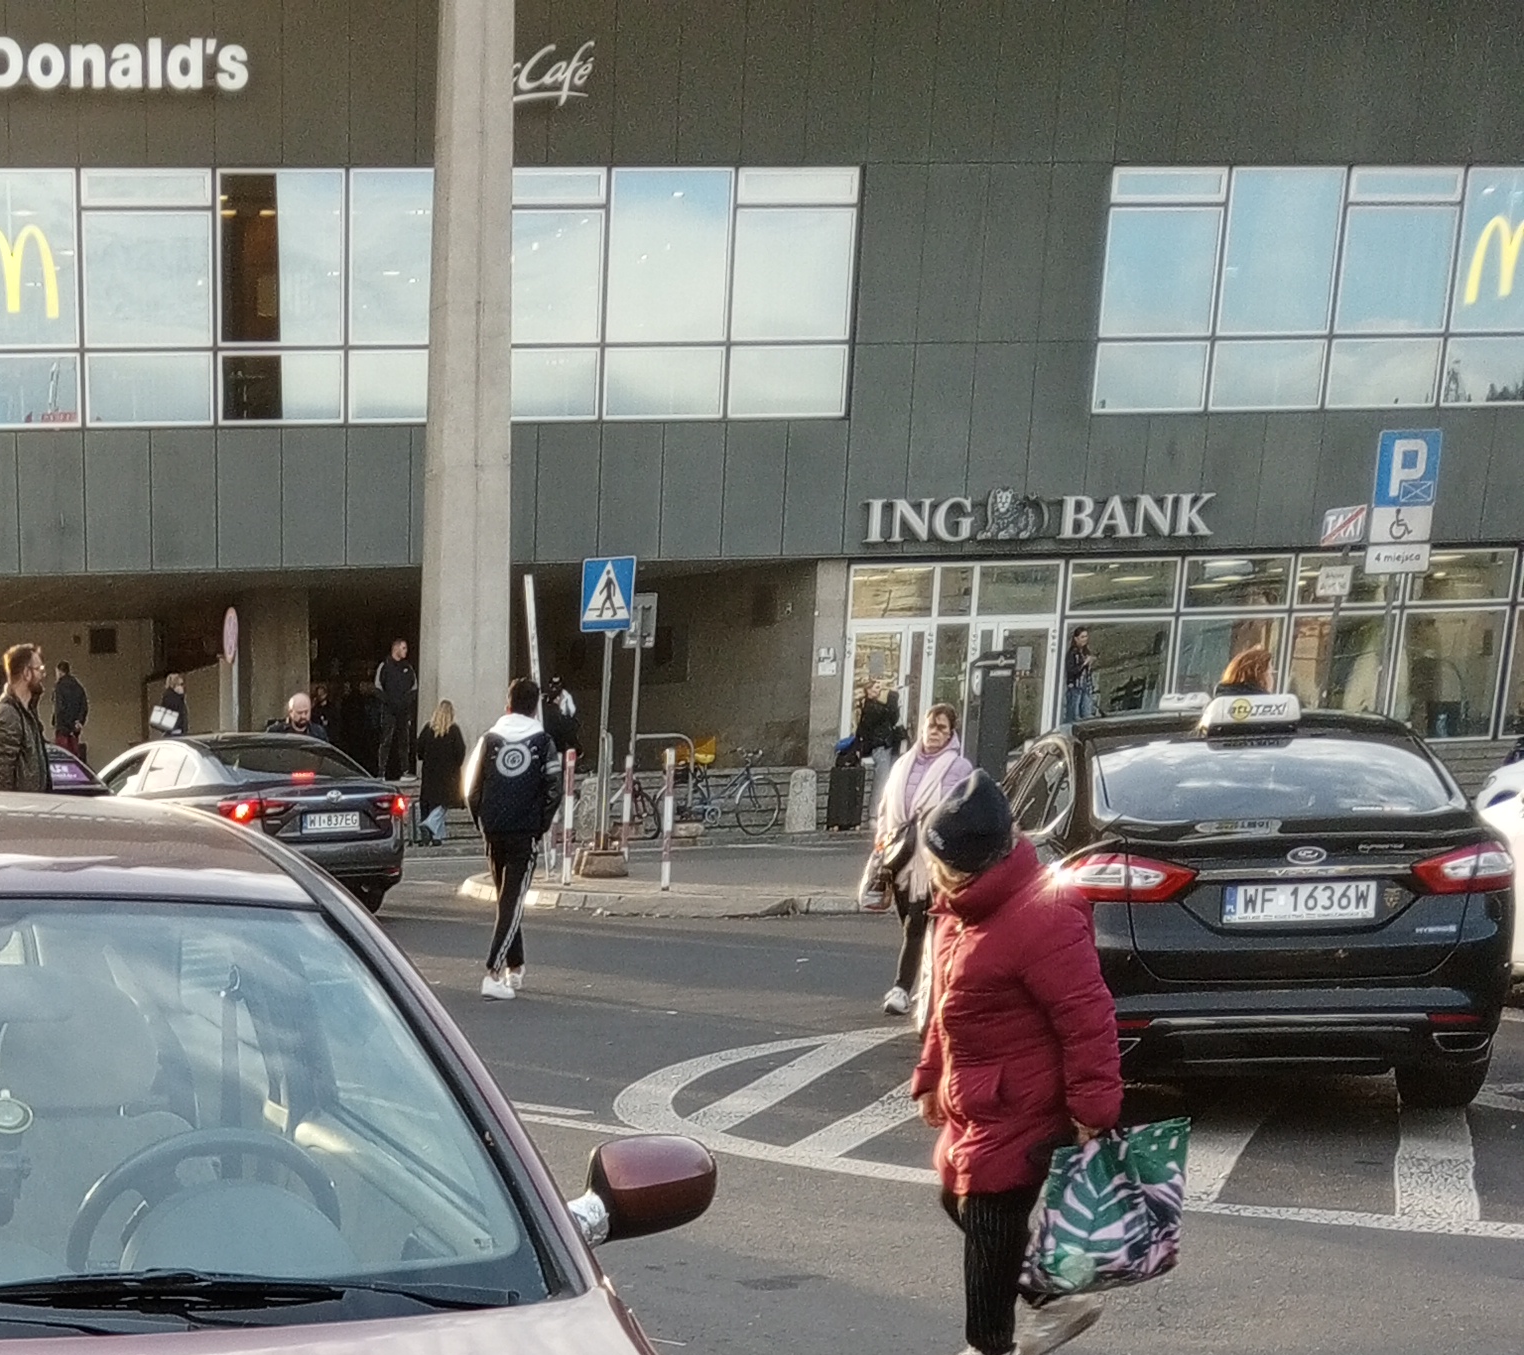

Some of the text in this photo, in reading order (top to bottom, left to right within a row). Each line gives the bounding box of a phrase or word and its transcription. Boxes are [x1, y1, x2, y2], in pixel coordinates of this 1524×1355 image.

[513, 41, 595, 106] Café
[1389, 438, 1428, 497] P
[862, 492, 1216, 542] ING BANK
[1326, 513, 1363, 538] TAXI
[1384, 554, 1421, 564] miejsca
[1244, 888, 1277, 914] WF
[1290, 884, 1370, 912] 1636W
